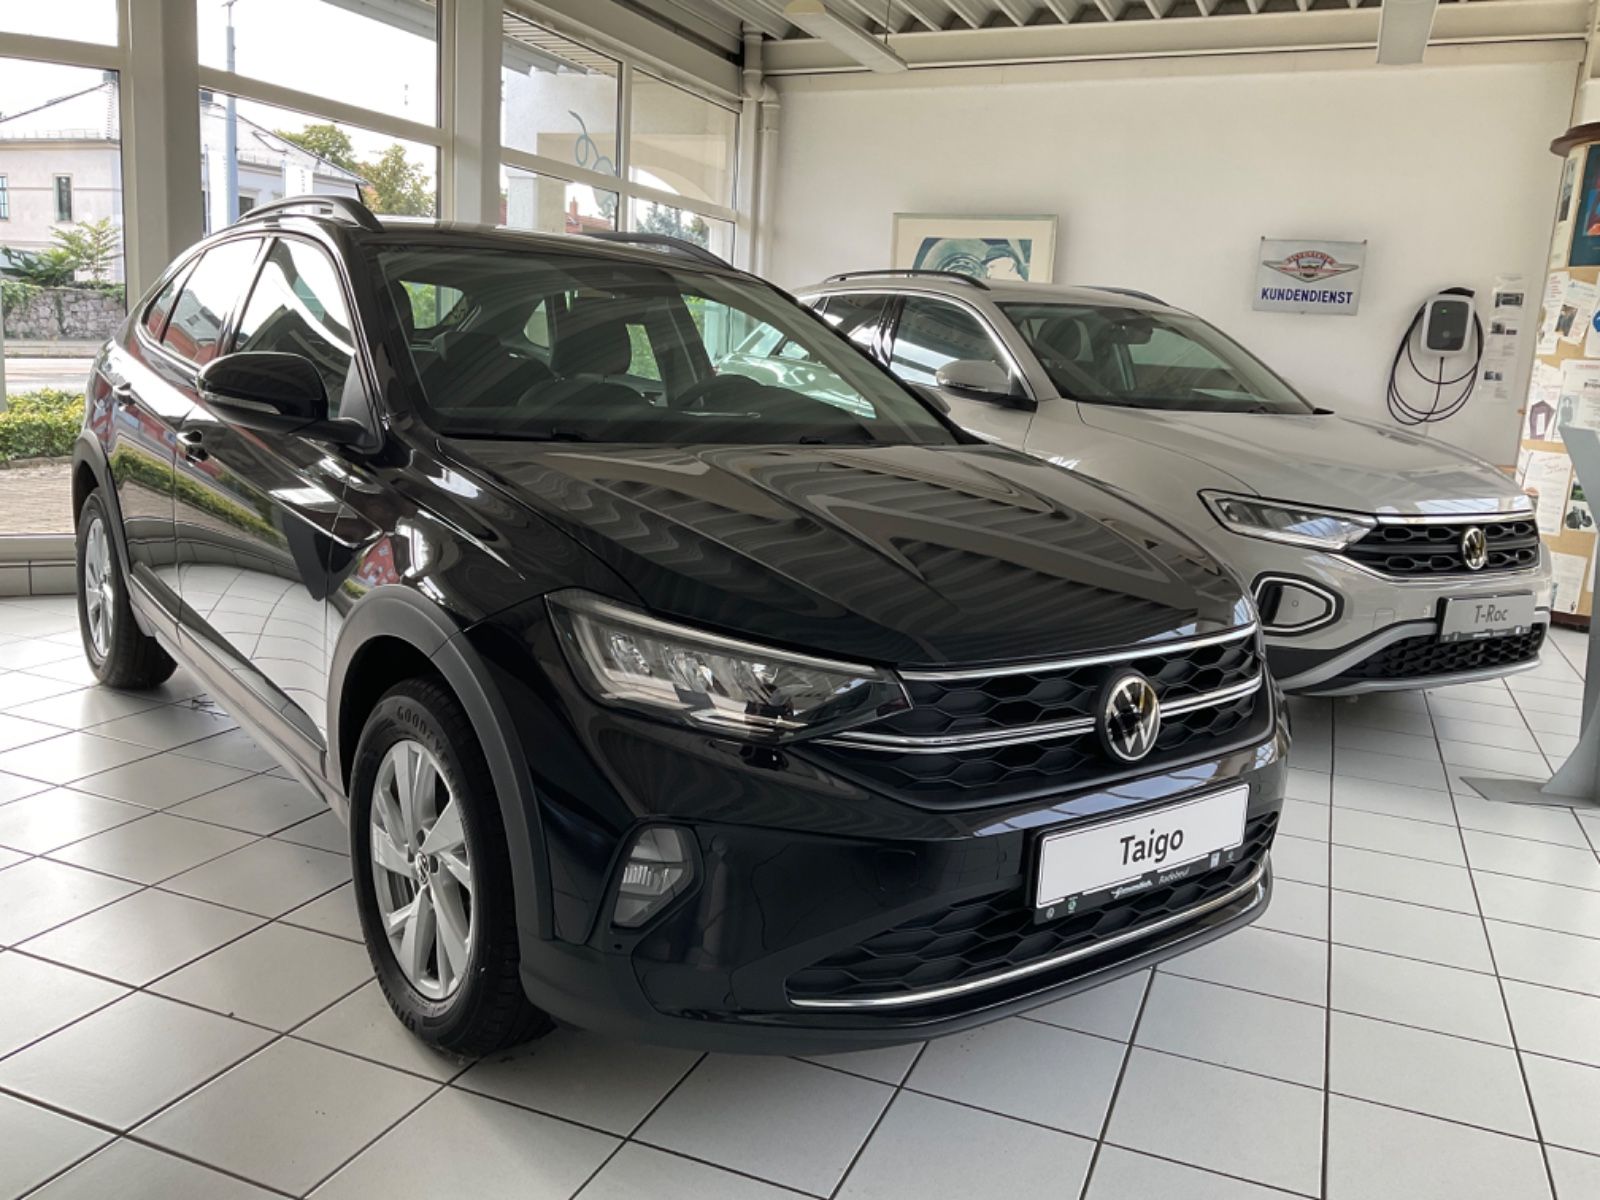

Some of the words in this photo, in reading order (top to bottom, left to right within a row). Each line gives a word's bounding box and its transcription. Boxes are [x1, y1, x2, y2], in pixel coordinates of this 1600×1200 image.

[1261, 287, 1353, 304] KUNDENDIENST
[1474, 604, 1509, 623] T-Roc
[1119, 828, 1184, 866] Taigo
